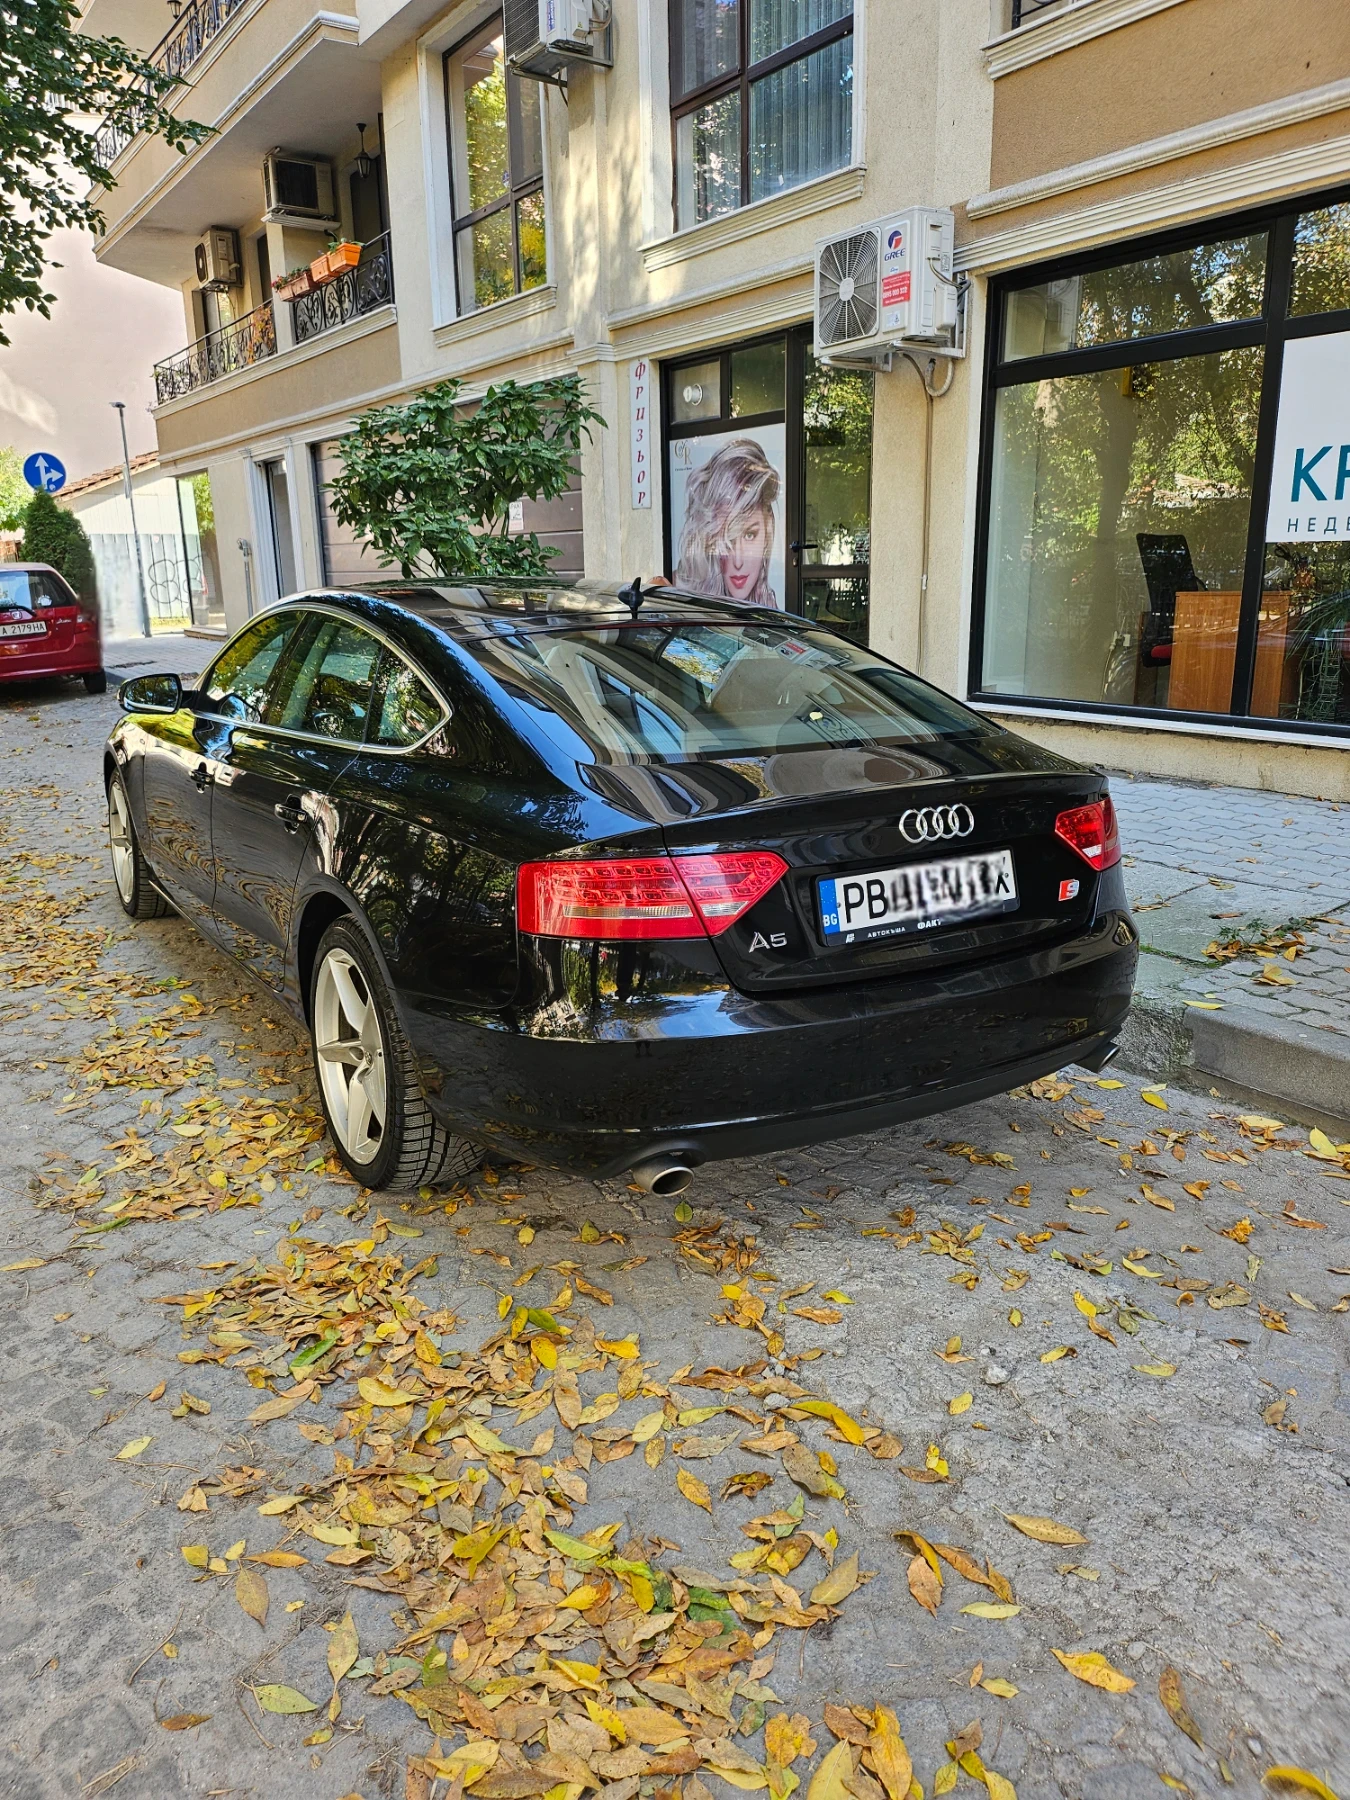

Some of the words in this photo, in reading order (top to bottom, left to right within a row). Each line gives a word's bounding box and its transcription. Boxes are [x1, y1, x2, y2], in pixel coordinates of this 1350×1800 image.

[884, 248, 906, 261] GREE
[823, 913, 838, 927] BG
[749, 931, 787, 953] A5
